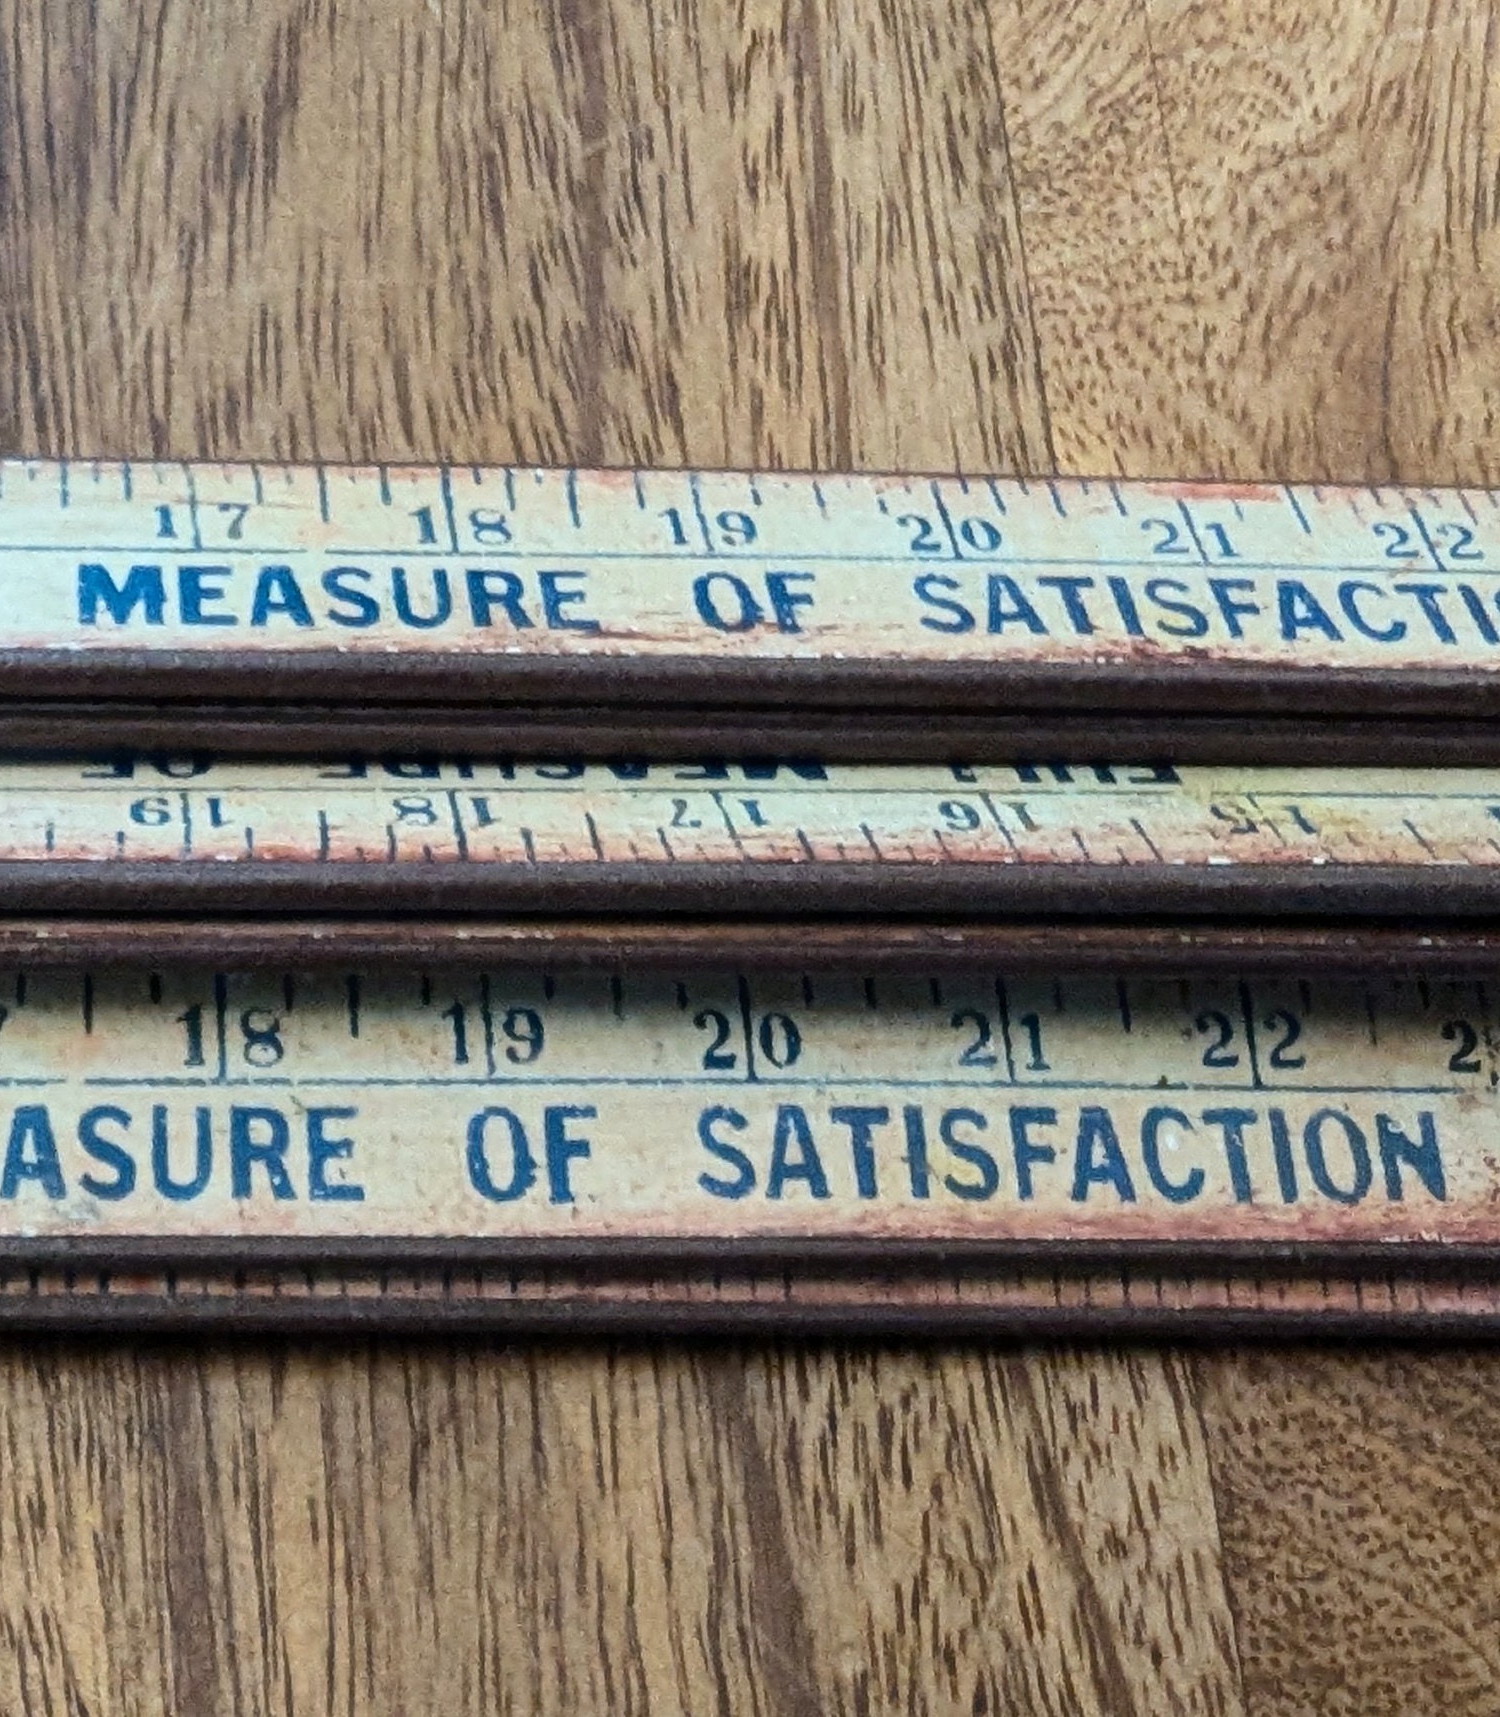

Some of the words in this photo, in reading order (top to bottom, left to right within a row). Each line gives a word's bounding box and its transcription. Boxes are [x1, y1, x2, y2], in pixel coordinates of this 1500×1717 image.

[153, 502, 252, 540] 17
[407, 505, 514, 546] 18
[656, 506, 759, 547] 19
[897, 512, 1002, 553] 20
[1139, 517, 1240, 558] 21
[1372, 522, 1484, 559] 22
[77, 563, 602, 631] MEASURE
[692, 569, 817, 634] OF
[913, 571, 1500, 647] SATISFACTI
[129, 797, 236, 828] 19
[392, 797, 502, 828] 18
[670, 798, 770, 828] 17
[938, 801, 1042, 833] 16
[176, 1003, 287, 1068] 18
[441, 1002, 547, 1067] 19
[693, 1009, 804, 1072] 20
[950, 1009, 1053, 1072] 21
[1194, 1009, 1306, 1070] 22
[465, 1104, 600, 1205] OF
[696, 1103, 1452, 1206] SATISFACTION
